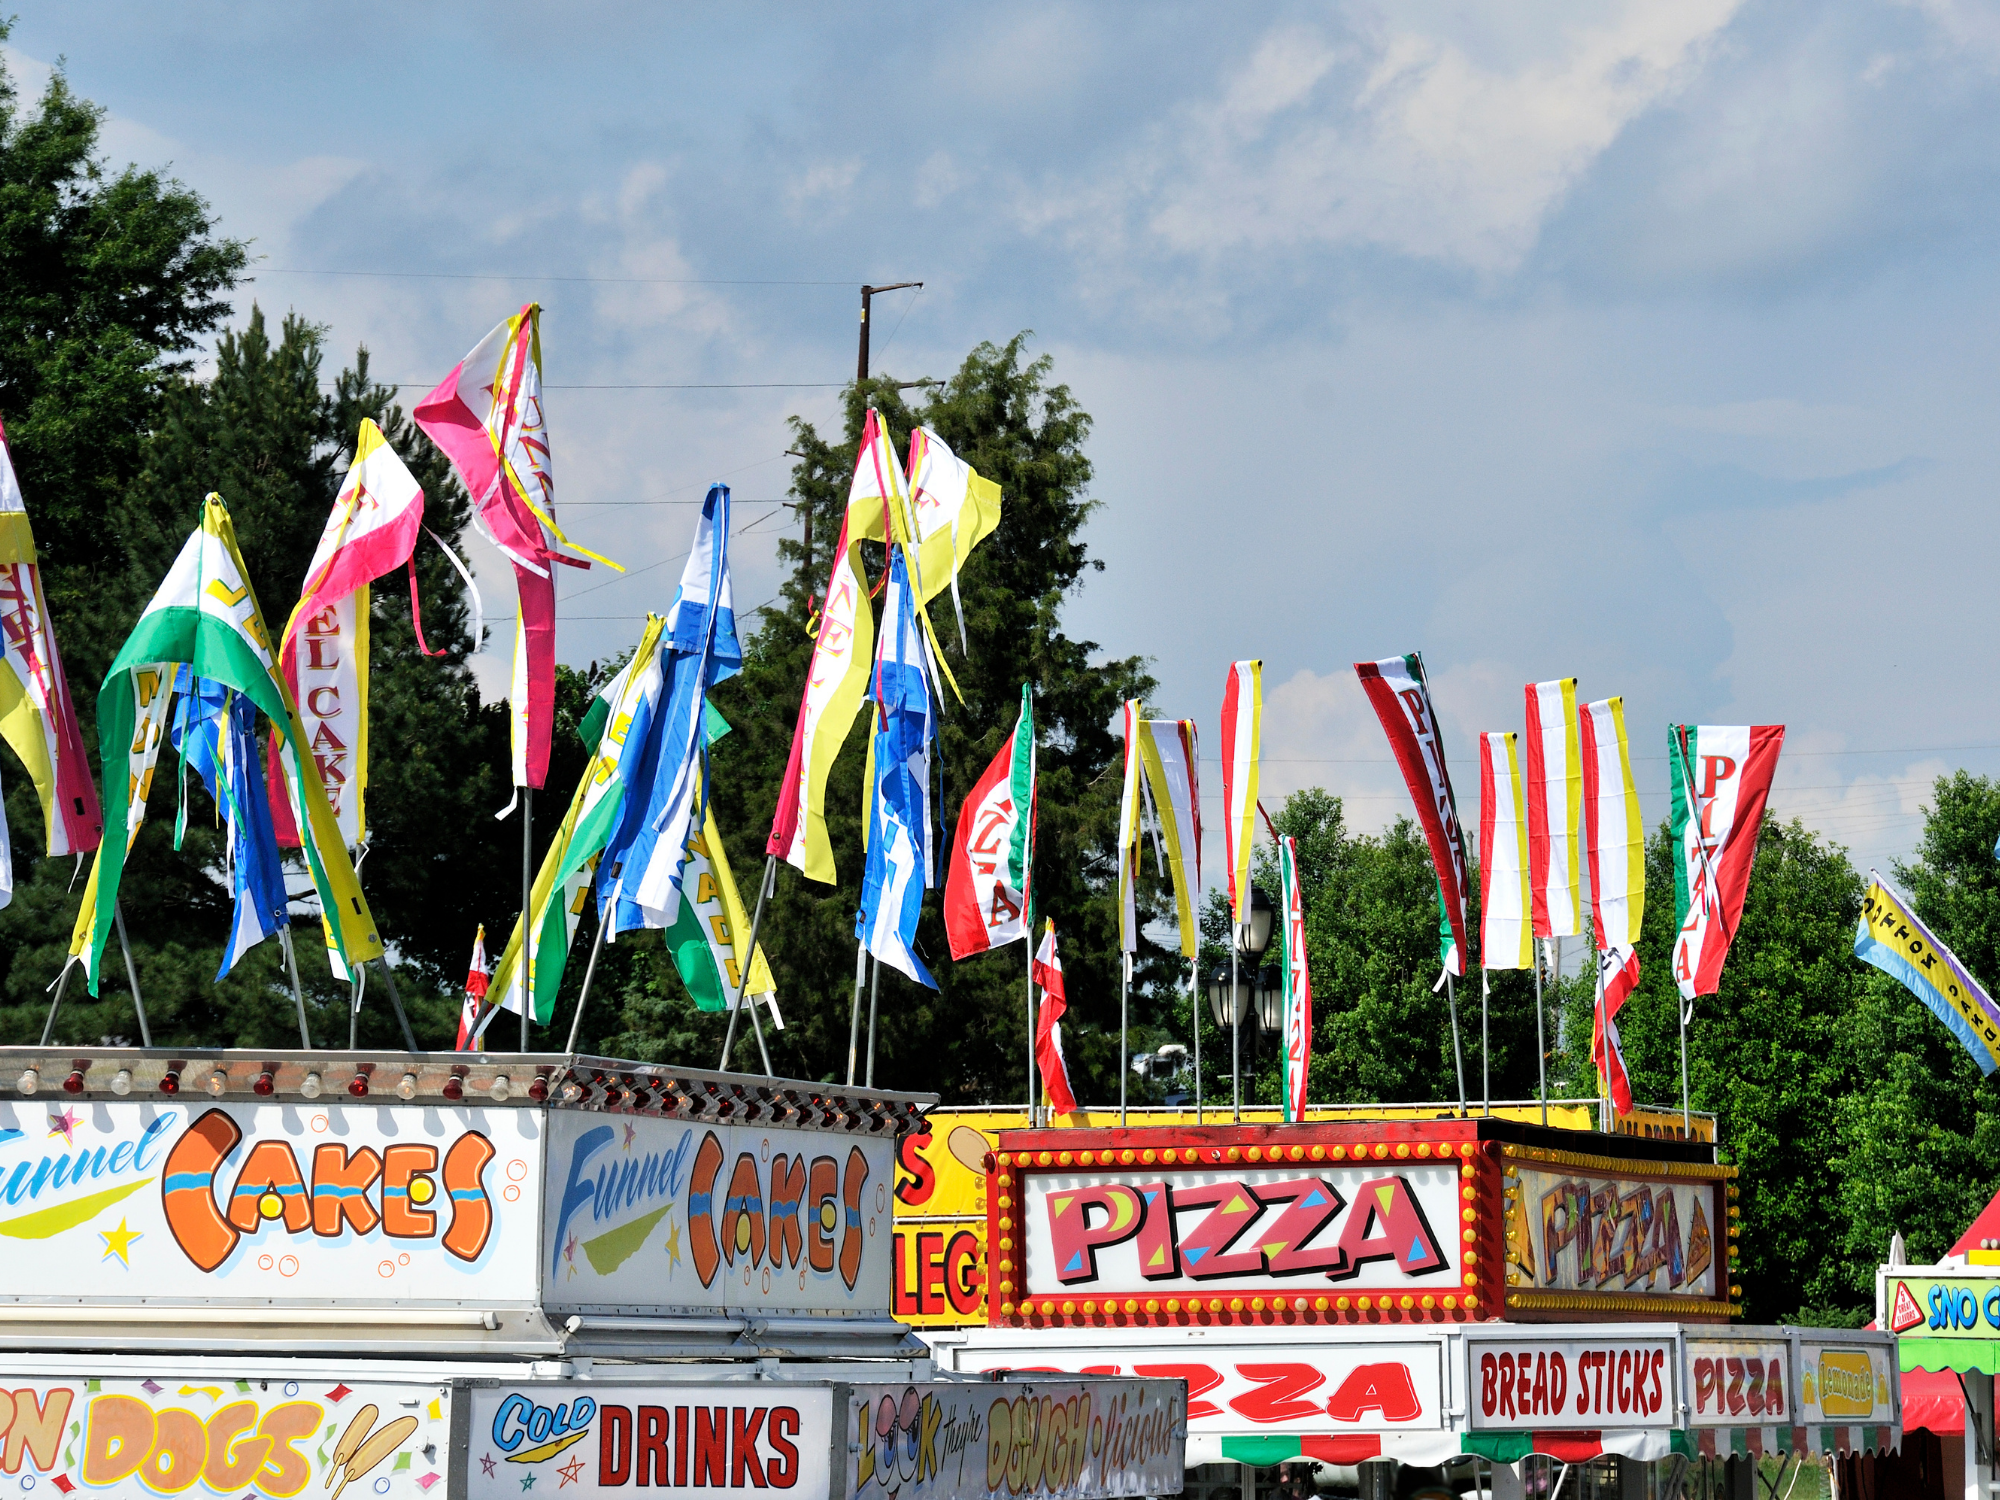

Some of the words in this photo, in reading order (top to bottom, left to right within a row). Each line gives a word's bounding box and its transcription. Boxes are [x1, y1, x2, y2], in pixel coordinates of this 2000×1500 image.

[162, 1107, 496, 1273] CAKES
[552, 1125, 693, 1281] Funnel
[688, 1130, 869, 1291] CAKES
[1046, 1175, 1450, 1286] PIZZA
[1541, 1178, 1686, 1291] PIZZA
[892, 1230, 990, 1316] LEG
[1897, 1300, 1912, 1314] GREAT
[1900, 1290, 1906, 1303] 5
[1928, 1284, 1978, 1331] SNO
[1896, 1309, 1916, 1325] FLAVORS
[1481, 1351, 1567, 1421] BREAD
[1577, 1349, 1664, 1418] STICKS
[1694, 1357, 1784, 1416] PIZZA
[1820, 1361, 1872, 1402] Lemonade
[83, 1394, 325, 1498] DOGS
[492, 1393, 597, 1451] COLD
[598, 1404, 800, 1488] DRINKS
